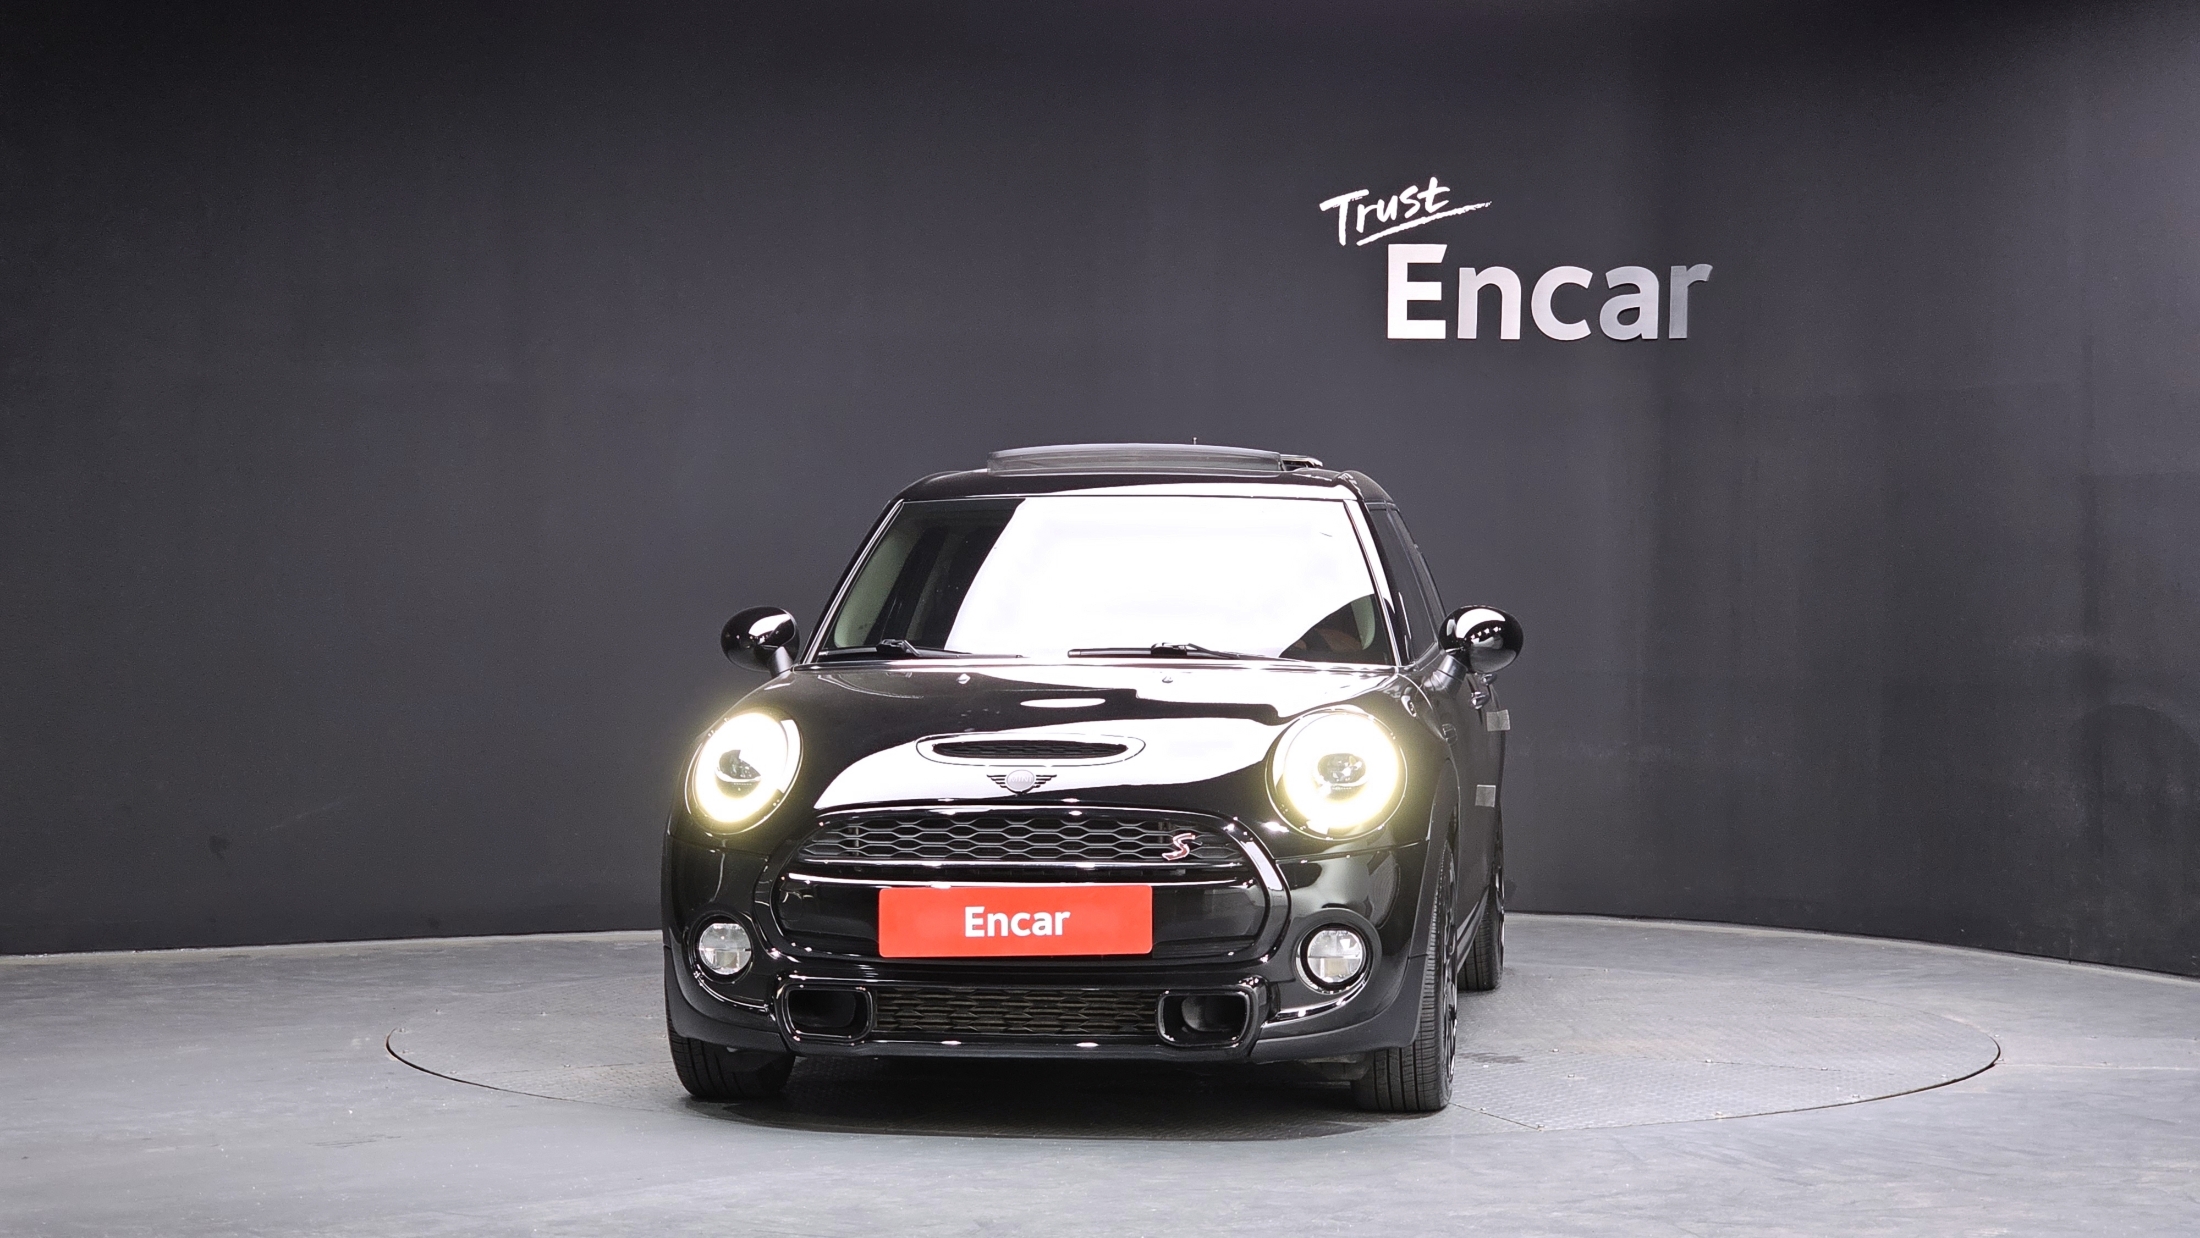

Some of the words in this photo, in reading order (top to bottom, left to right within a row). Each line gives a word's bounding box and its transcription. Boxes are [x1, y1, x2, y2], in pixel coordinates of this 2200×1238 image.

[1319, 176, 1452, 246] Trust
[1387, 243, 1713, 341] Encar
[1008, 775, 1034, 783] MINI
[1162, 832, 1196, 861] S
[964, 906, 1071, 937] Encar
